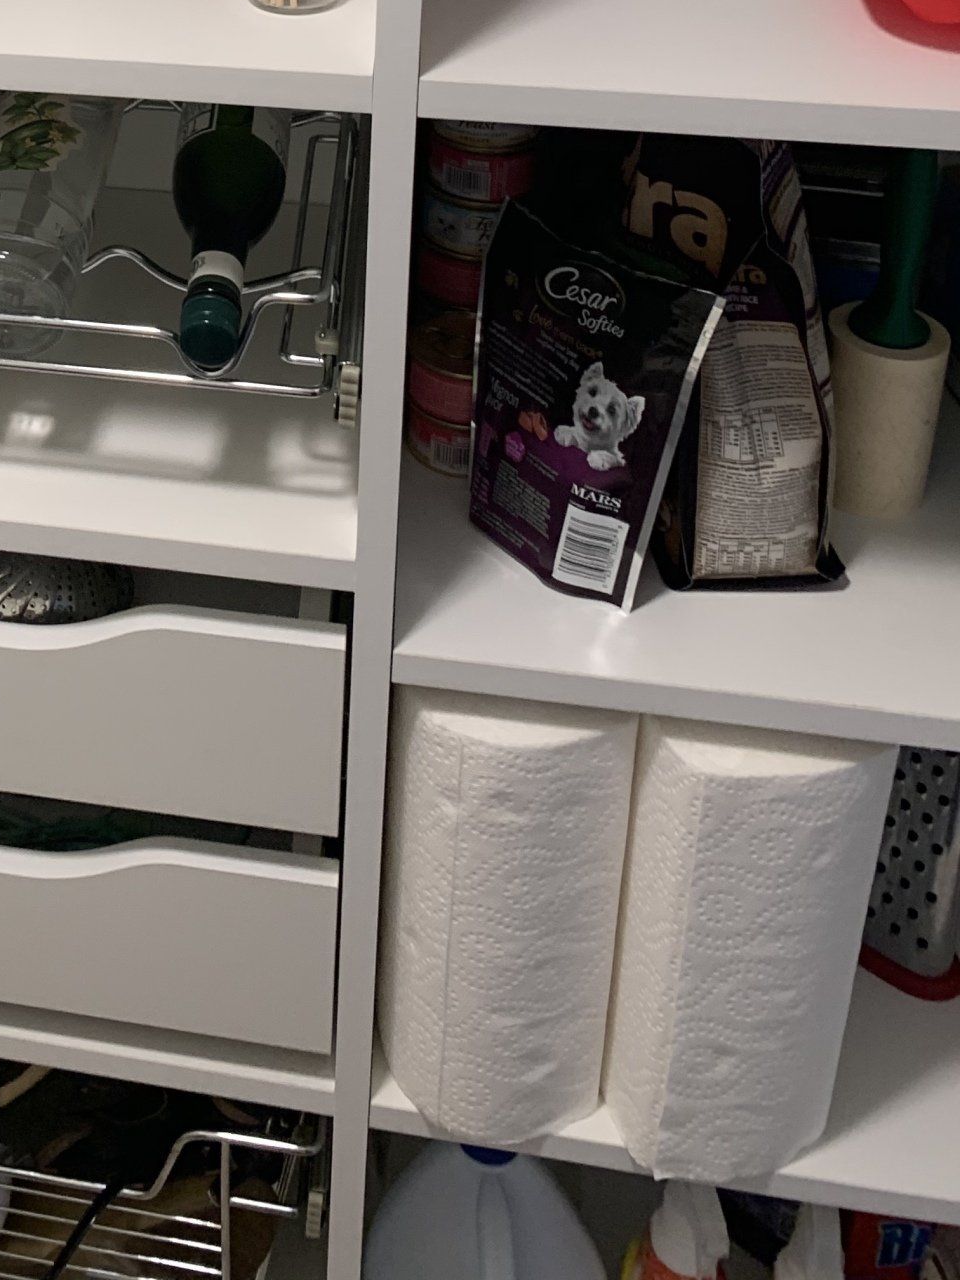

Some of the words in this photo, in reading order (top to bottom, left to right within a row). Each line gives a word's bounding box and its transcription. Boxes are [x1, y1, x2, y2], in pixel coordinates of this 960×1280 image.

[544, 266, 617, 311] Cesar
[577, 308, 625, 339] Softies
[570, 483, 622, 509] MARS
